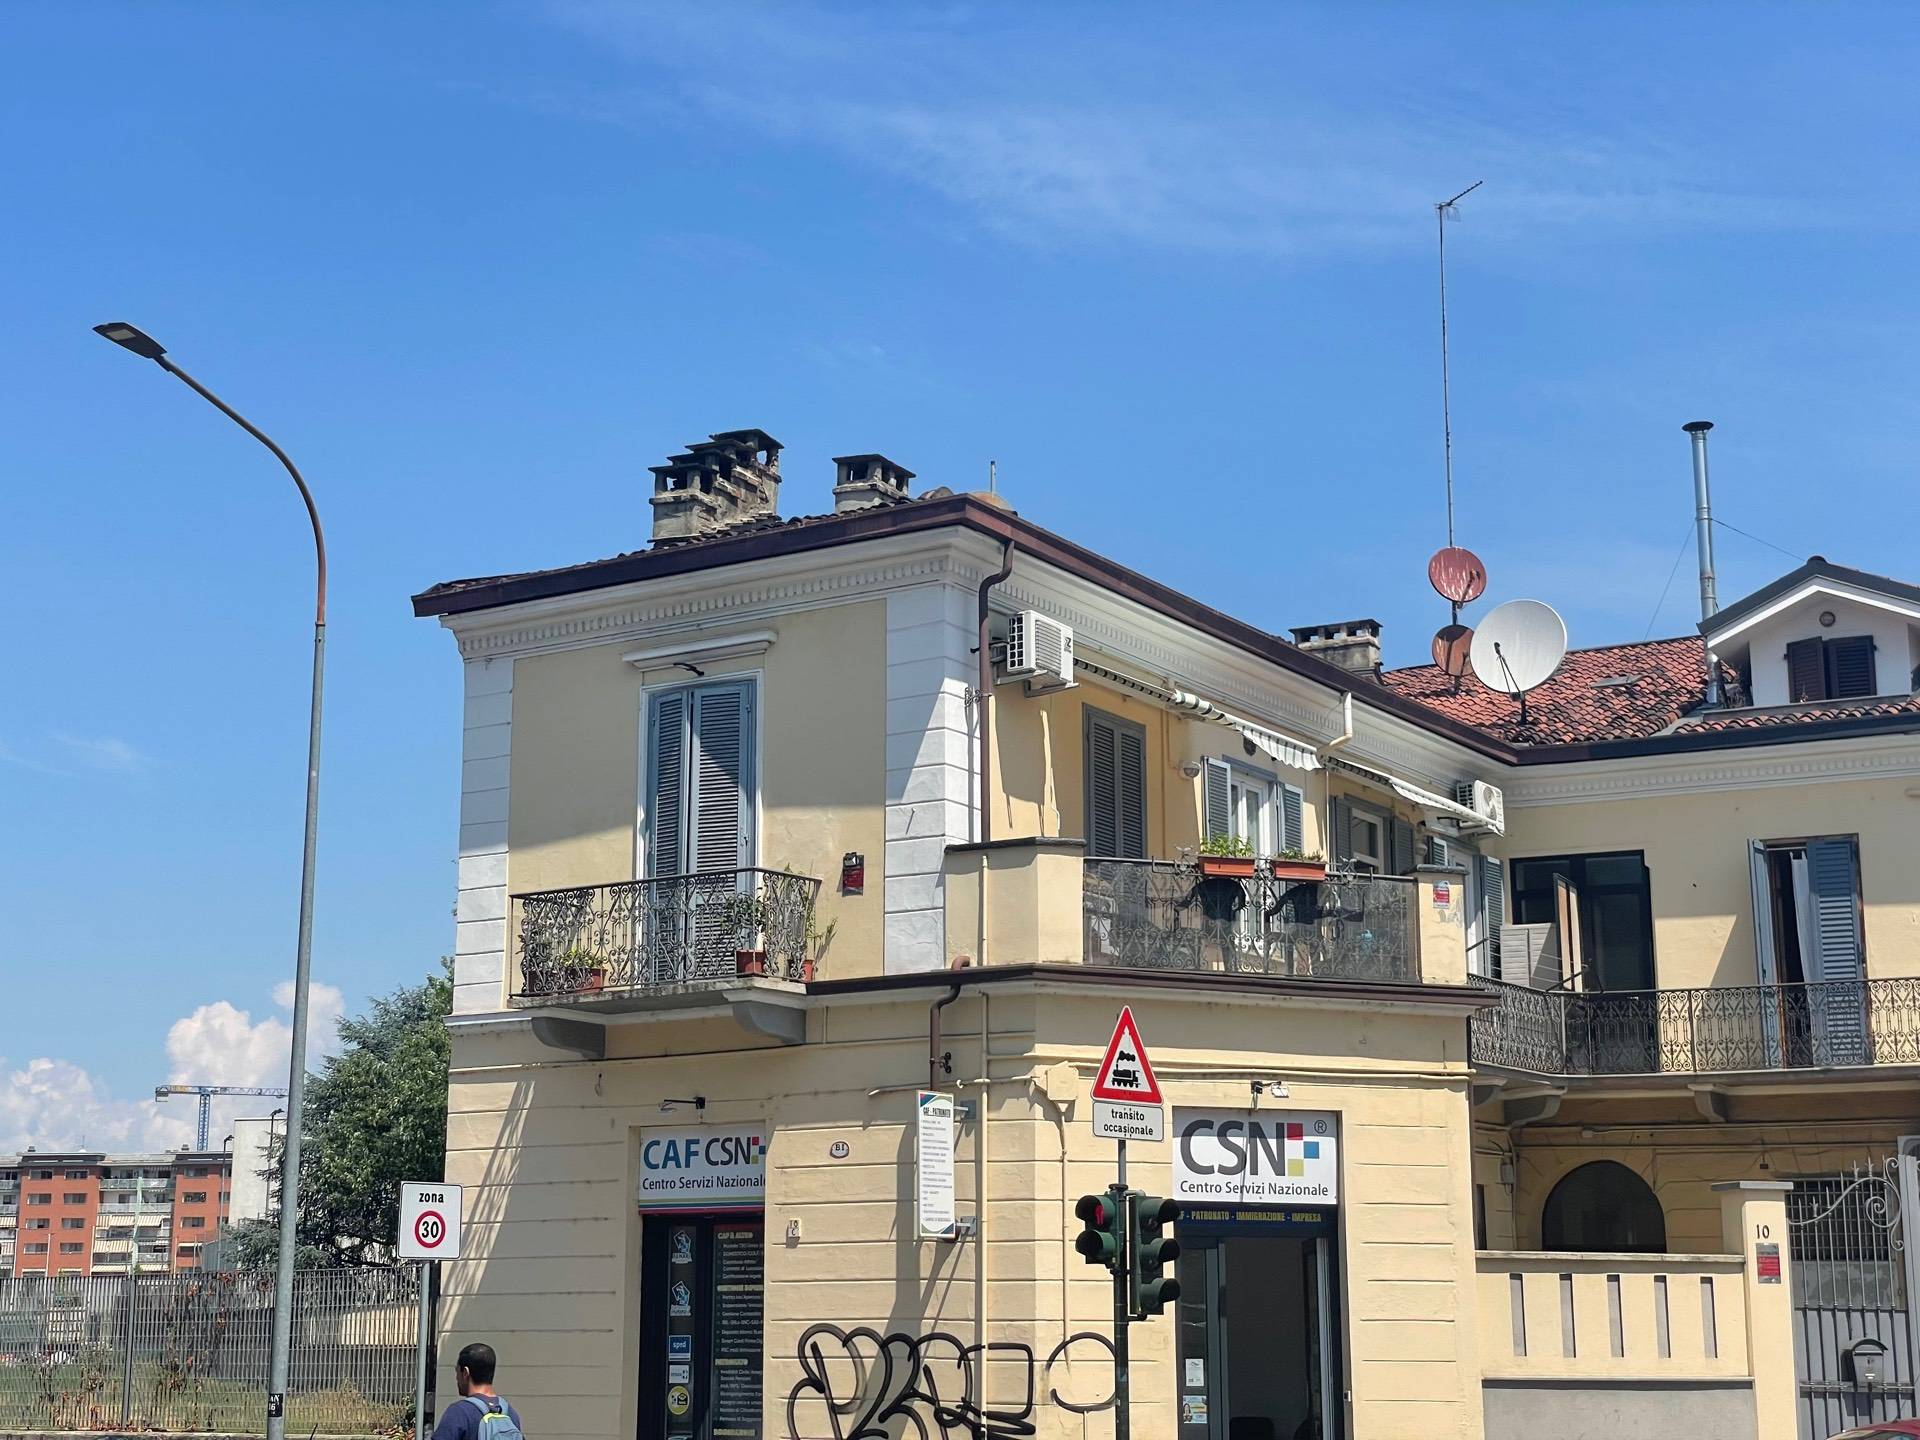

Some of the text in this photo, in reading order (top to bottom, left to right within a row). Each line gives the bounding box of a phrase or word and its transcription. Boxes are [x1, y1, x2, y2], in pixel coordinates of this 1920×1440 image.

[1111, 1108, 1145, 1121] transito
[1103, 1123, 1154, 1136] occasionale
[643, 1136, 751, 1170] CAF CSN
[1180, 1119, 1286, 1177] CSN
[642, 1177, 676, 1190] Centro
[678, 1175, 714, 1189] Servizi
[1180, 1180, 1329, 1196] Centro Servizi Nazionale
[418, 1192, 445, 1203] zona
[1191, 1210, 1230, 1221] PATRONATO
[1236, 1211, 1286, 1222] IMMIGRAZIONE
[1291, 1212, 1322, 1223] IMPRESA
[421, 1220, 440, 1239] 30
[1756, 1224, 1770, 1240] 10
